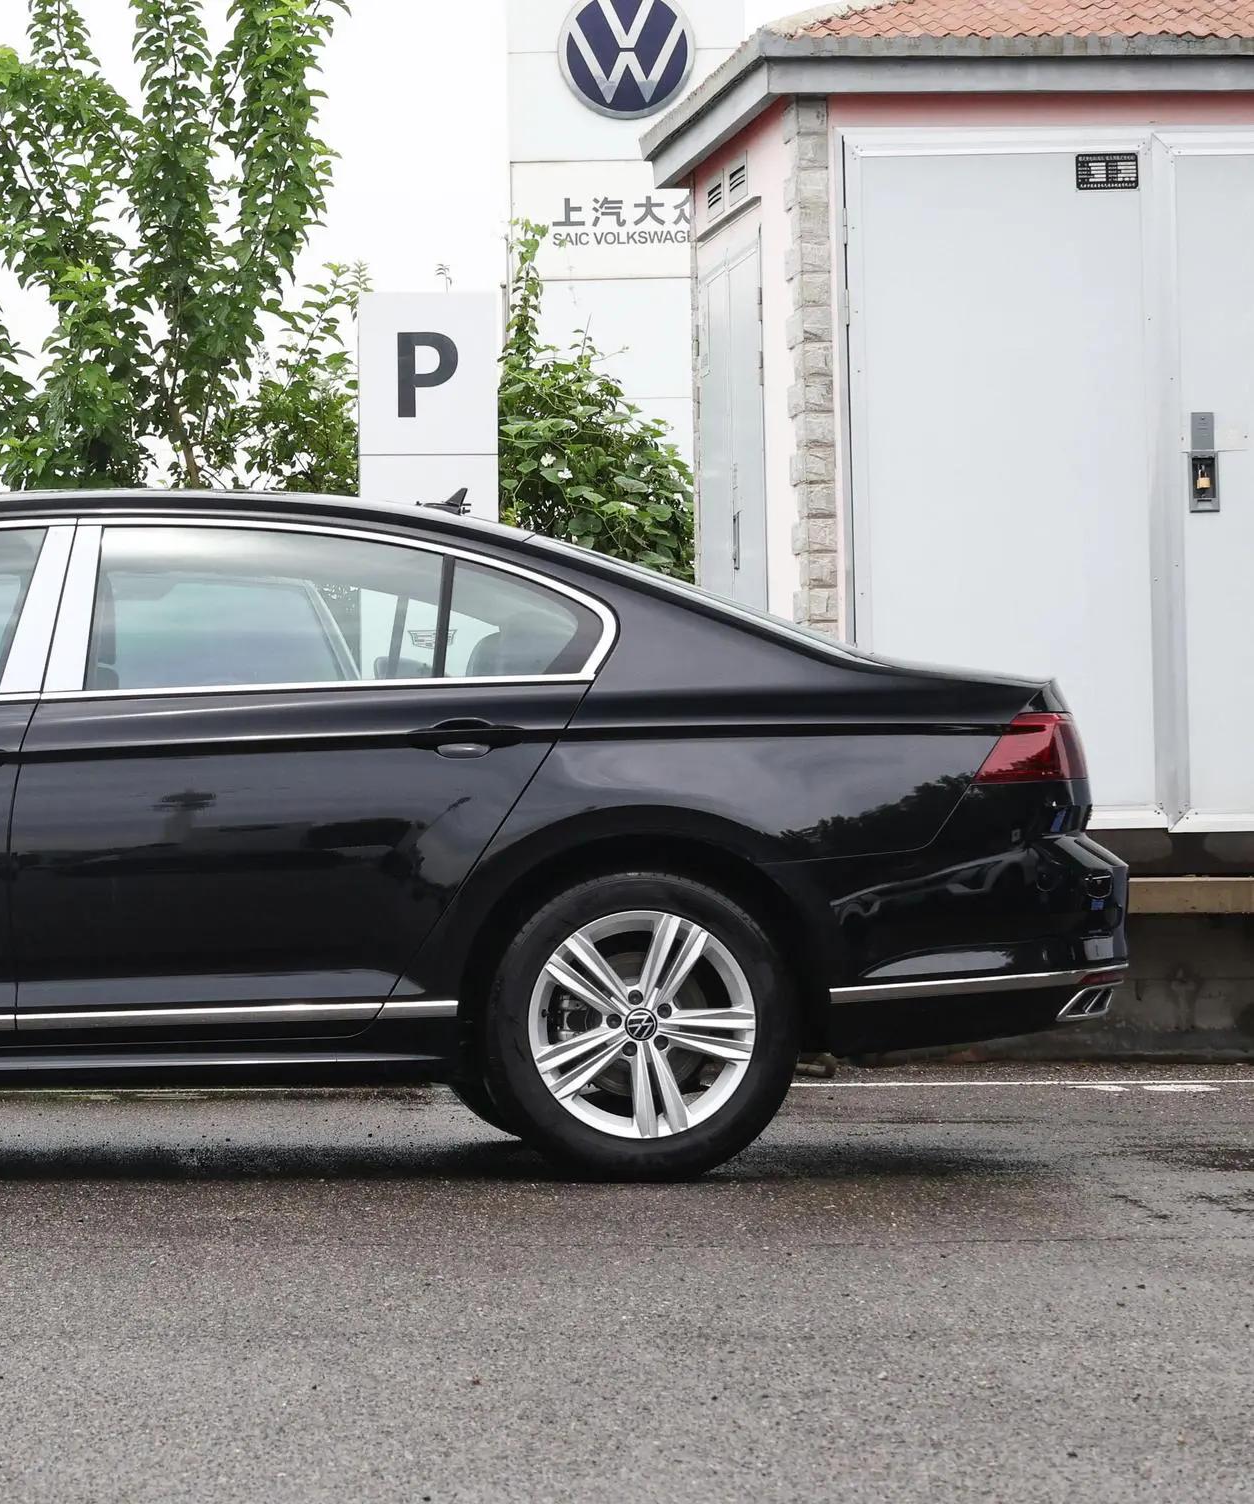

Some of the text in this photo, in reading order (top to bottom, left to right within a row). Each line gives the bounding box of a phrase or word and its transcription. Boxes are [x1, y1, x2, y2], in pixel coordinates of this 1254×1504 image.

[553, 230, 690, 246] SAIC VOLKSWAG
[397, 332, 459, 418] P
